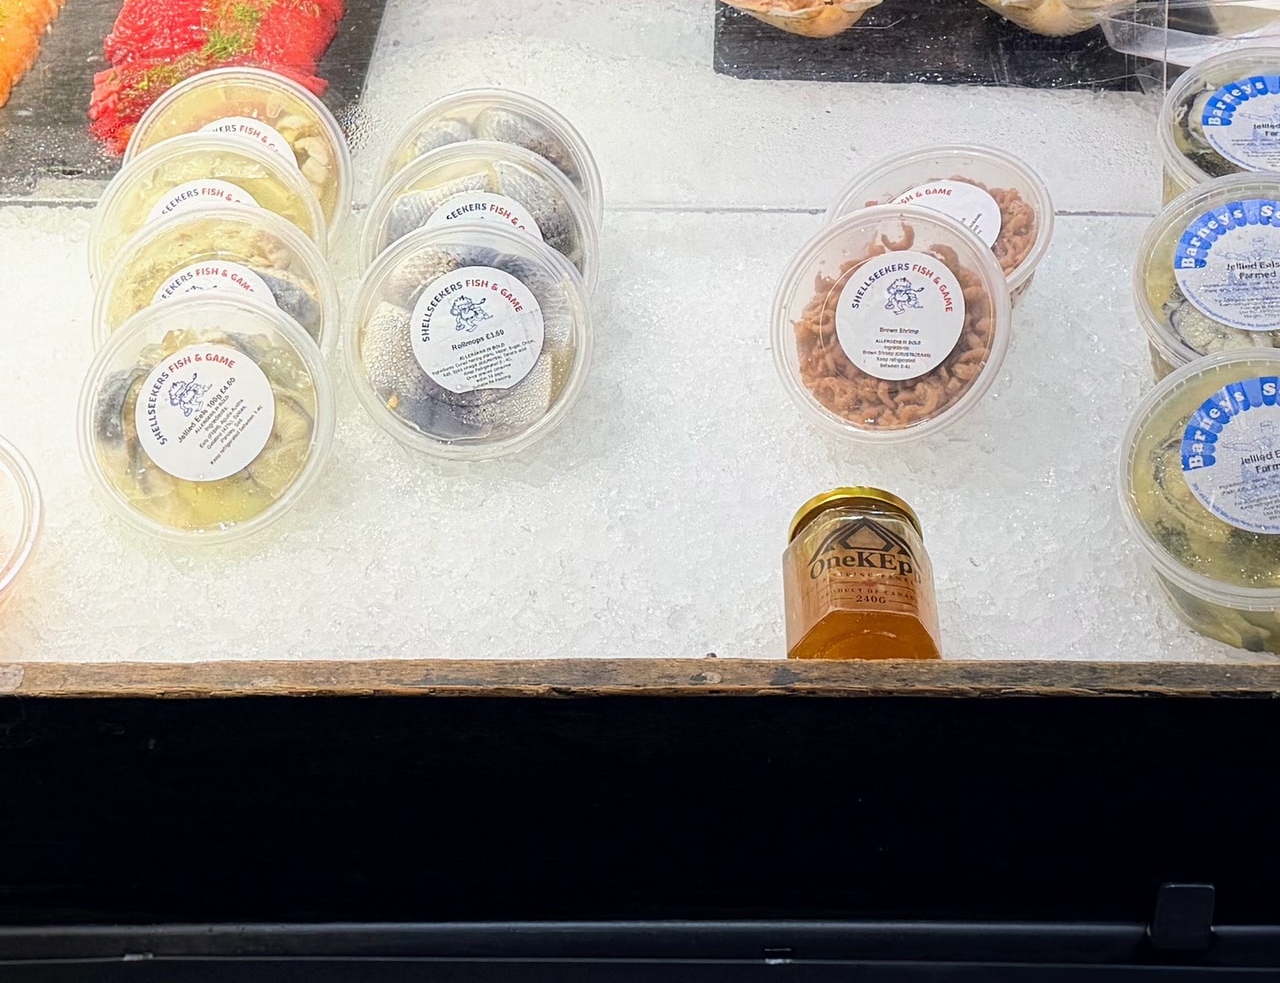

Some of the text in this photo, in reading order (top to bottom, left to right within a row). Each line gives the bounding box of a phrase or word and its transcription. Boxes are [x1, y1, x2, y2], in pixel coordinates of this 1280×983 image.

[1208, 79, 1266, 126] Barneys
[239, 125, 261, 137] FISH
[1253, 122, 1280, 131] Jellied
[201, 188, 224, 198] FISH
[925, 188, 952, 197] GAME
[490, 204, 511, 219] FISH
[1181, 208, 1243, 269] Barneys
[196, 268, 219, 277] FISH
[221, 269, 228, 277] &
[1226, 261, 1280, 271] Jellied Eels
[1239, 270, 1277, 280] Farmed
[852, 263, 953, 313] SHELLSEEKERS FISH & GAME
[422, 279, 523, 343] SHELLSEEKERS FISH & GAME
[147, 353, 236, 447] SHELLSEEKERS FISH & GAME
[1188, 390, 1245, 469] Barneys
[1240, 451, 1274, 466] Jellied
[855, 595, 887, 604] 240G
